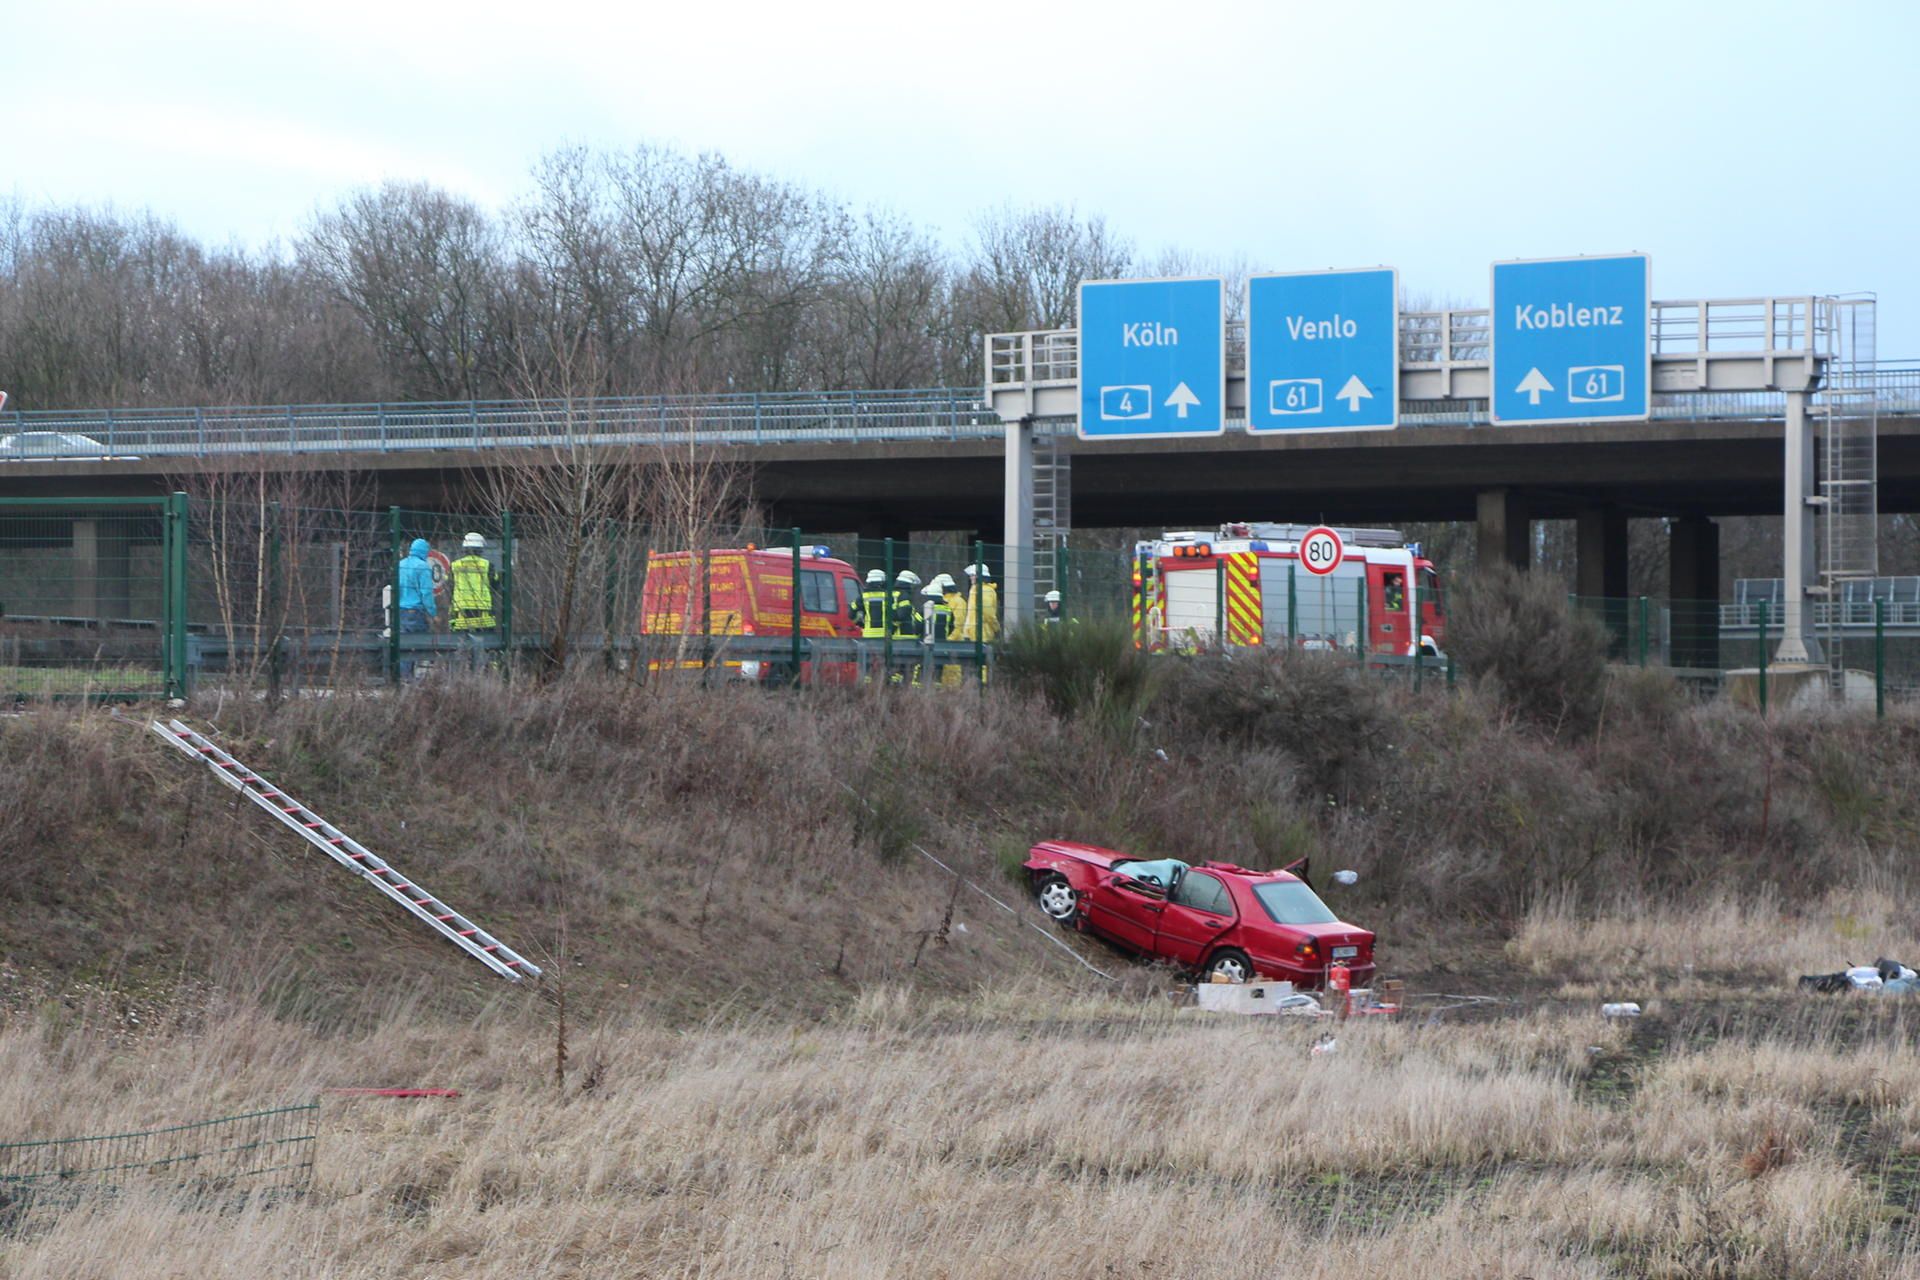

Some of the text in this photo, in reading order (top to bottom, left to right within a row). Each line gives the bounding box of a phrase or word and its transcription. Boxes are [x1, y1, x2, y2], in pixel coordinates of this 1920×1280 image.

[1515, 302, 1623, 329] Koblenz
[1123, 322, 1178, 347] Köln
[1286, 314, 1357, 340] Venlo
[1586, 373, 1607, 395] 61
[1119, 393, 1132, 413] 4
[1286, 386, 1306, 407] 61
[1309, 541, 1333, 562] 80
